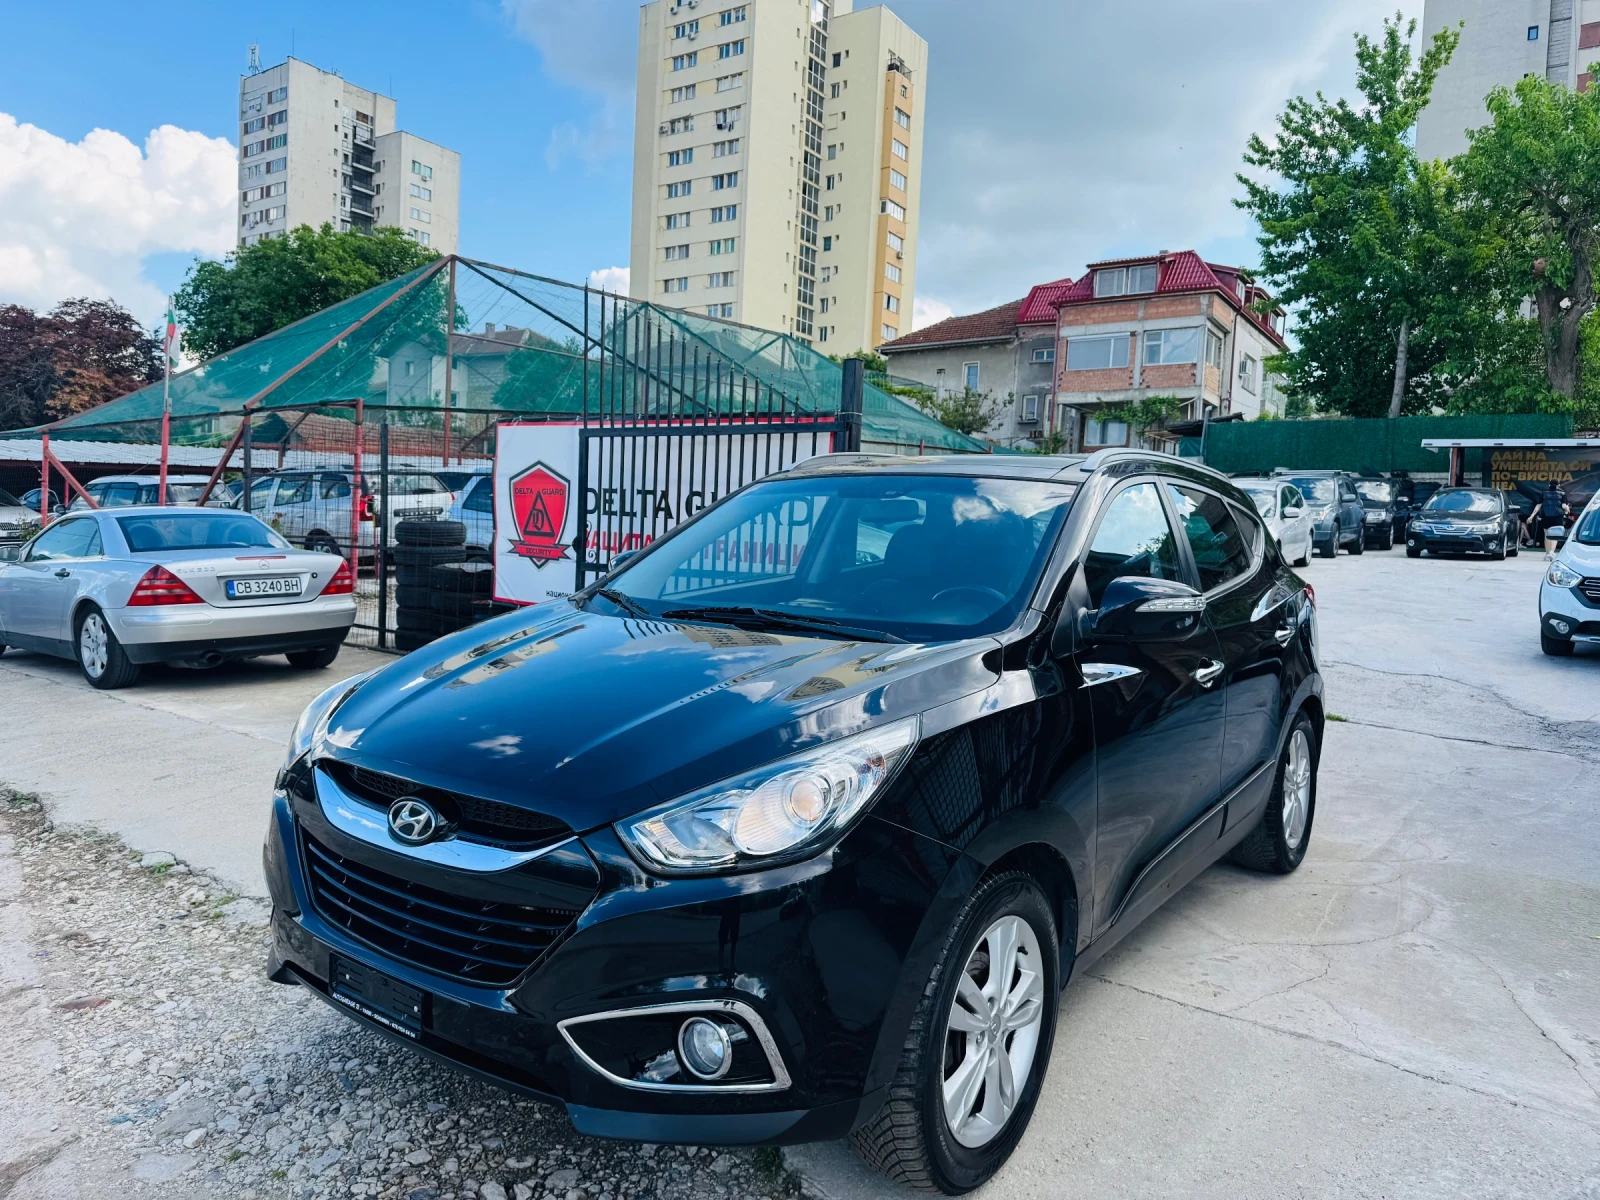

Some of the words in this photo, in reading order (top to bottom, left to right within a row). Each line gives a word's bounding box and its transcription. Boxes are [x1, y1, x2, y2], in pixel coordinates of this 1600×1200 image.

[1526, 451, 1547, 461] НА
[1491, 461, 1567, 471] УМЕНИЯТА
[541, 488, 564, 496] GUARD
[586, 487, 674, 520] DELTA
[525, 547, 552, 556] SECURITY
[236, 582, 252, 594] CB
[255, 580, 282, 593] 3240
[284, 579, 299, 591] BH
